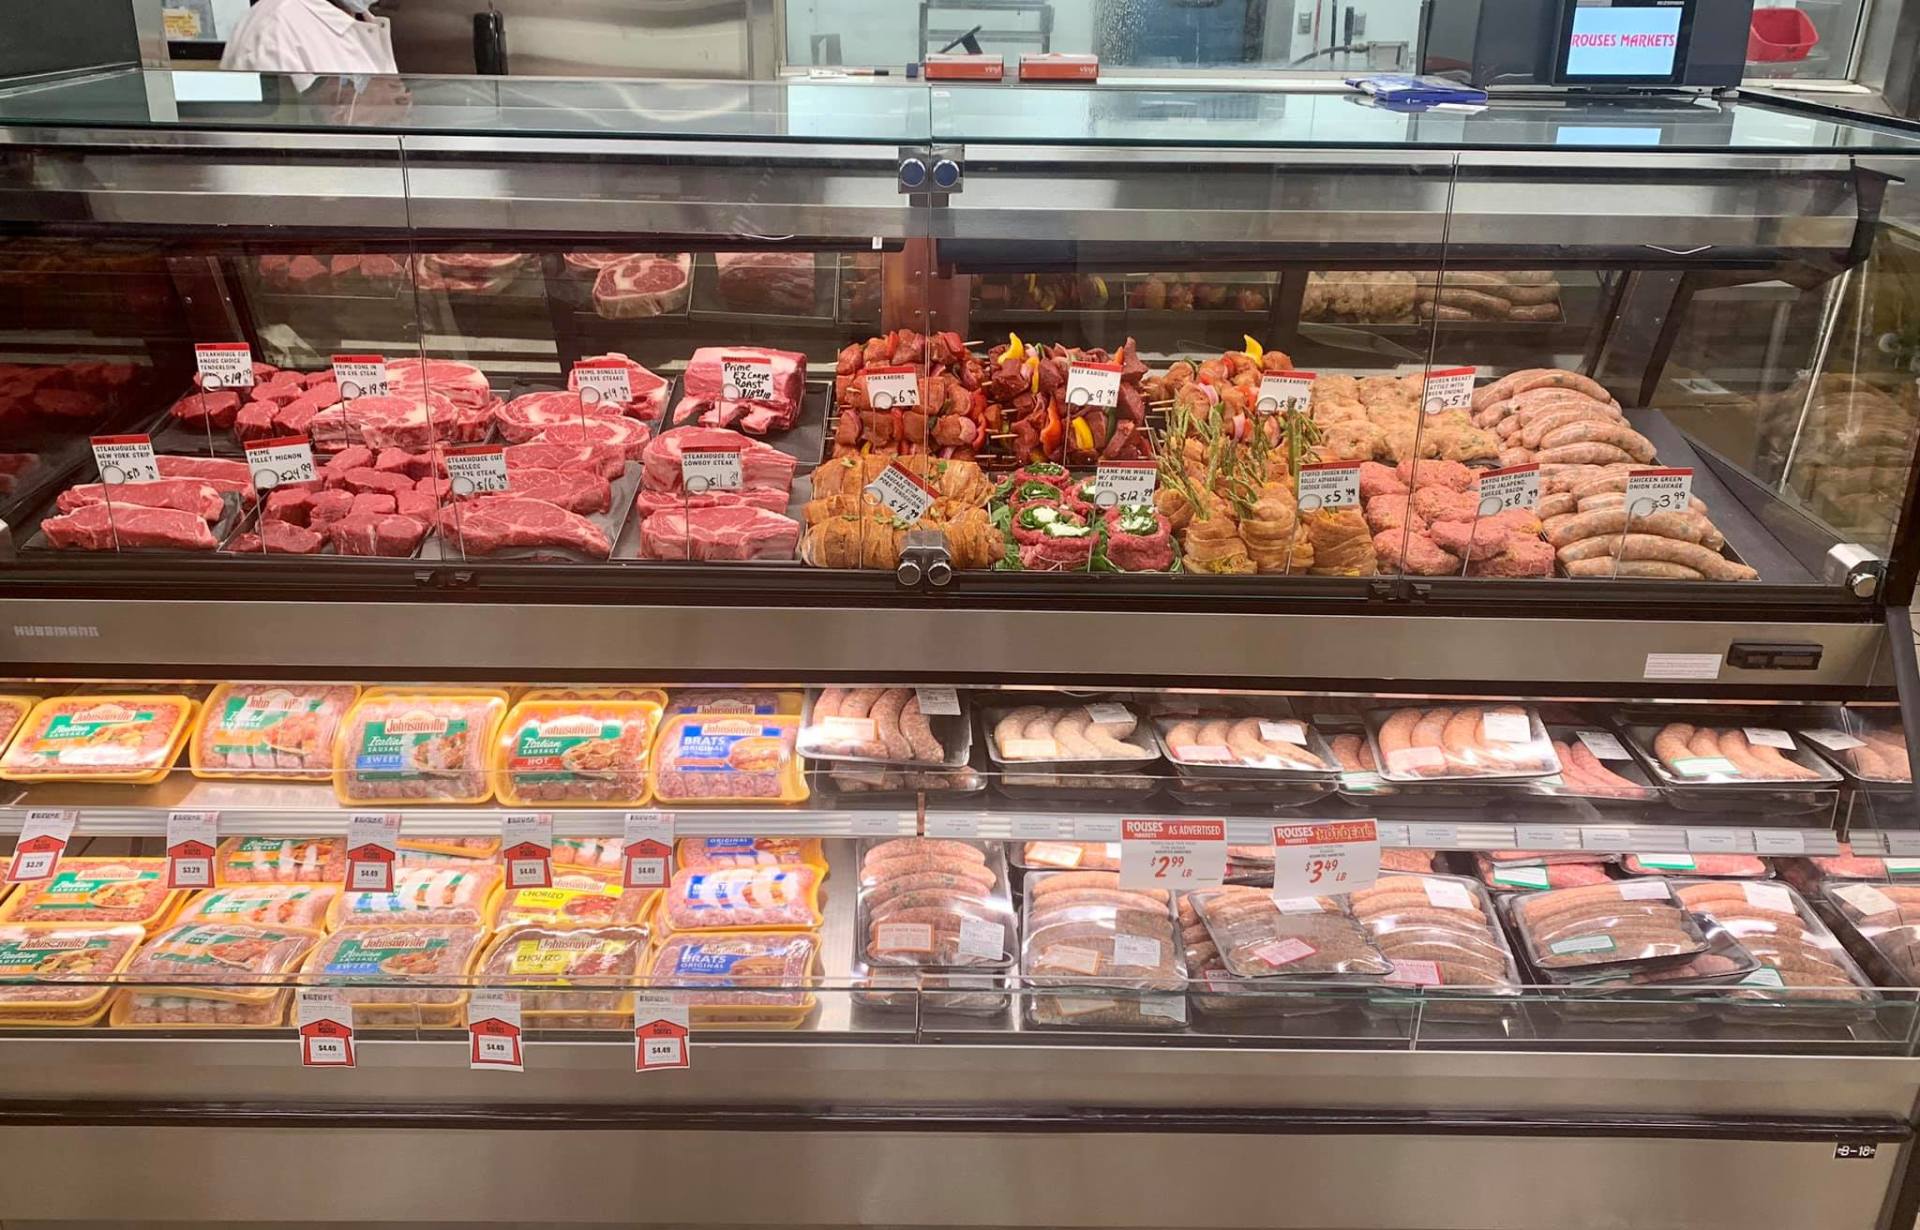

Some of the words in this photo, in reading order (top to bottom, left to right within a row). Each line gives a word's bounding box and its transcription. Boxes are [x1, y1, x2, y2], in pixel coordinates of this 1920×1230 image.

[1572, 34, 1616, 47] ROUSES
[1620, 34, 1675, 47] MARKETS
[985, 65, 1001, 74] vinyl
[1079, 65, 1097, 74] vinyl
[724, 362, 751, 372] Prime
[735, 377, 764, 389] Roast
[13, 625, 100, 637] HUSSMANN
[75, 711, 134, 722] Johnsonville
[386, 719, 446, 733] Johnsonville
[523, 737, 562, 748] Italian
[684, 736, 726, 746] BRATS
[527, 758, 549, 766] HOT
[1126, 821, 1164, 834] ROUSES
[1168, 826, 1178, 835] AS
[1179, 825, 1221, 836] ADVERTISED
[1276, 826, 1314, 839] ROUSES
[1181, 869, 1193, 878] LB
[1336, 873, 1348, 882] LB
[522, 890, 564, 899] CHORIZO
[23, 938, 85, 949] Johnsonville
[318, 1044, 337, 1052] $4.49
[652, 1047, 672, 1055] $4.49
